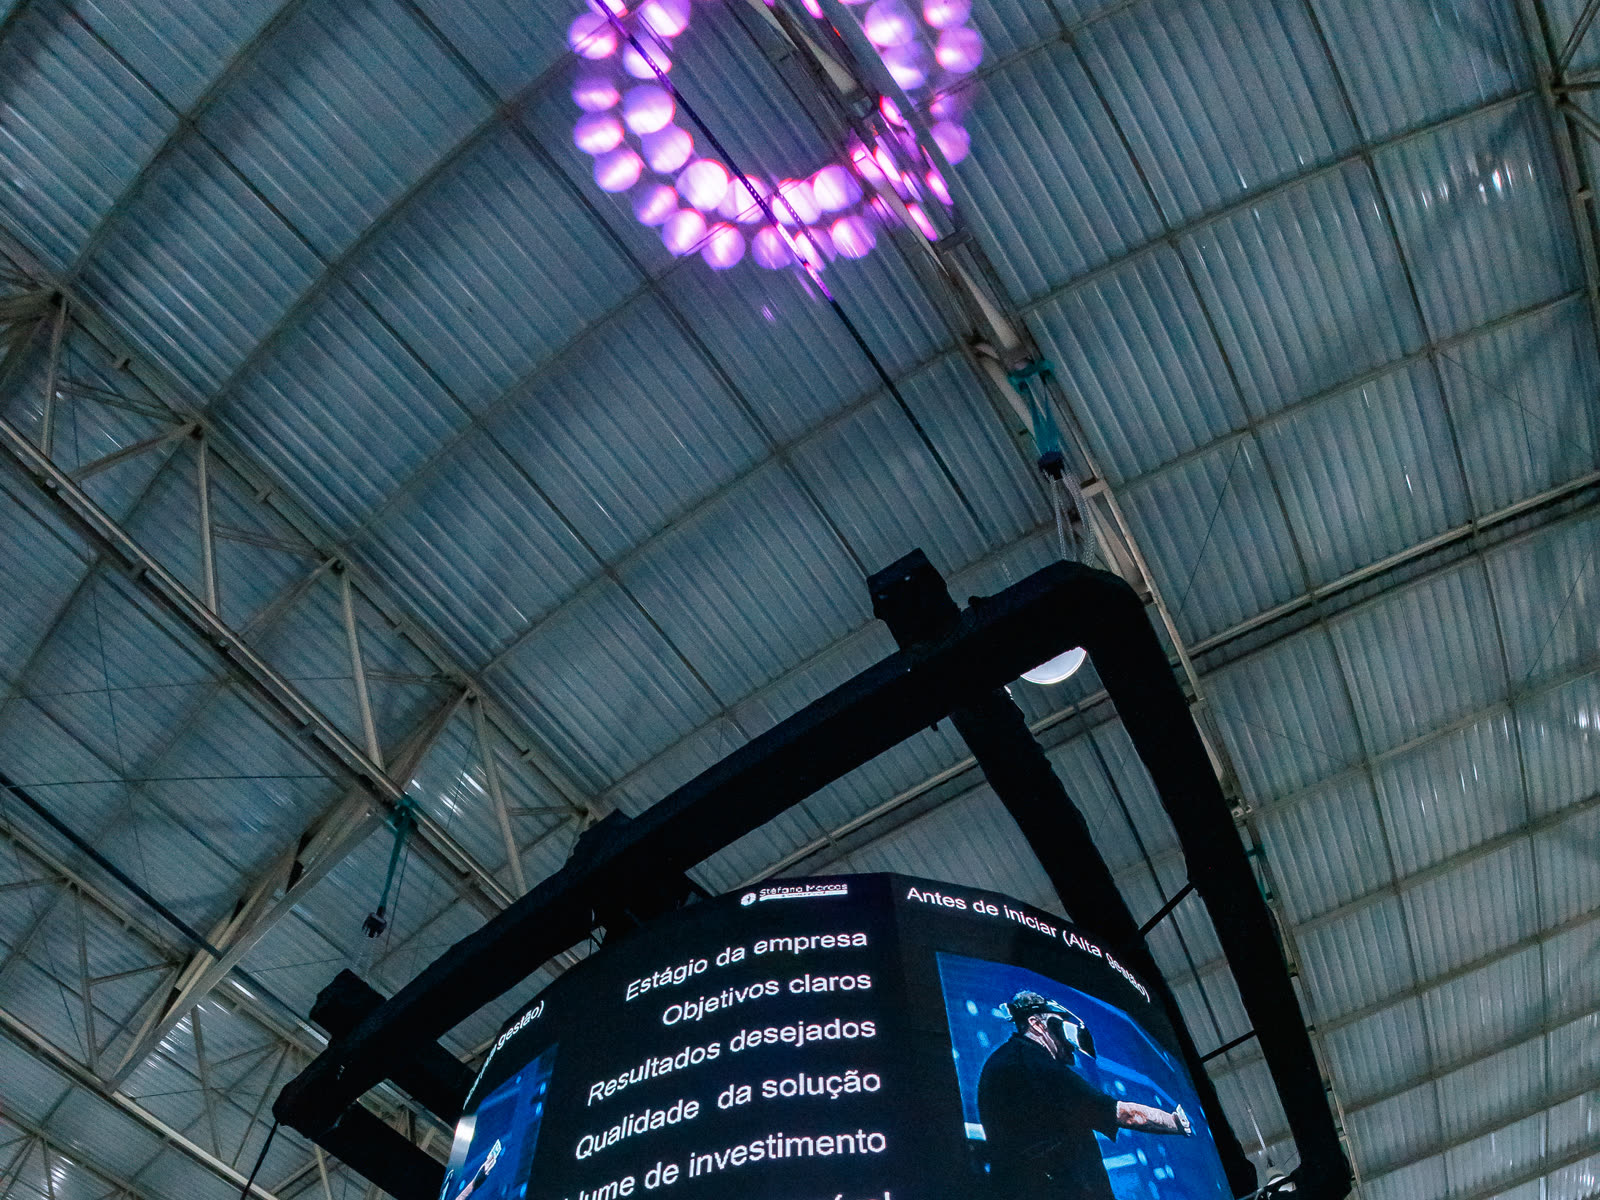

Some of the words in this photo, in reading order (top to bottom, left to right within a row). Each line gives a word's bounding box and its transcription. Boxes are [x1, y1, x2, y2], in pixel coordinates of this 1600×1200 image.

[907, 887, 967, 910] Antes
[972, 899, 1000, 916] de
[1004, 904, 1057, 938] iniciar
[1062, 929, 1103, 958] (Alta
[625, 958, 709, 1002] Estágio
[715, 947, 746, 967] da
[753, 932, 868, 956] empresa
[662, 979, 780, 1027] Objetivos
[788, 973, 872, 995] claros
[496, 999, 545, 1051] gestão)
[587, 1042, 721, 1107] Resultados
[729, 1017, 877, 1053] desejados
[575, 1098, 702, 1161] Qualidade
[717, 1083, 752, 1110] da
[761, 1068, 881, 1101] solução
[644, 1160, 680, 1190] de
[688, 1127, 887, 1178] investimento
